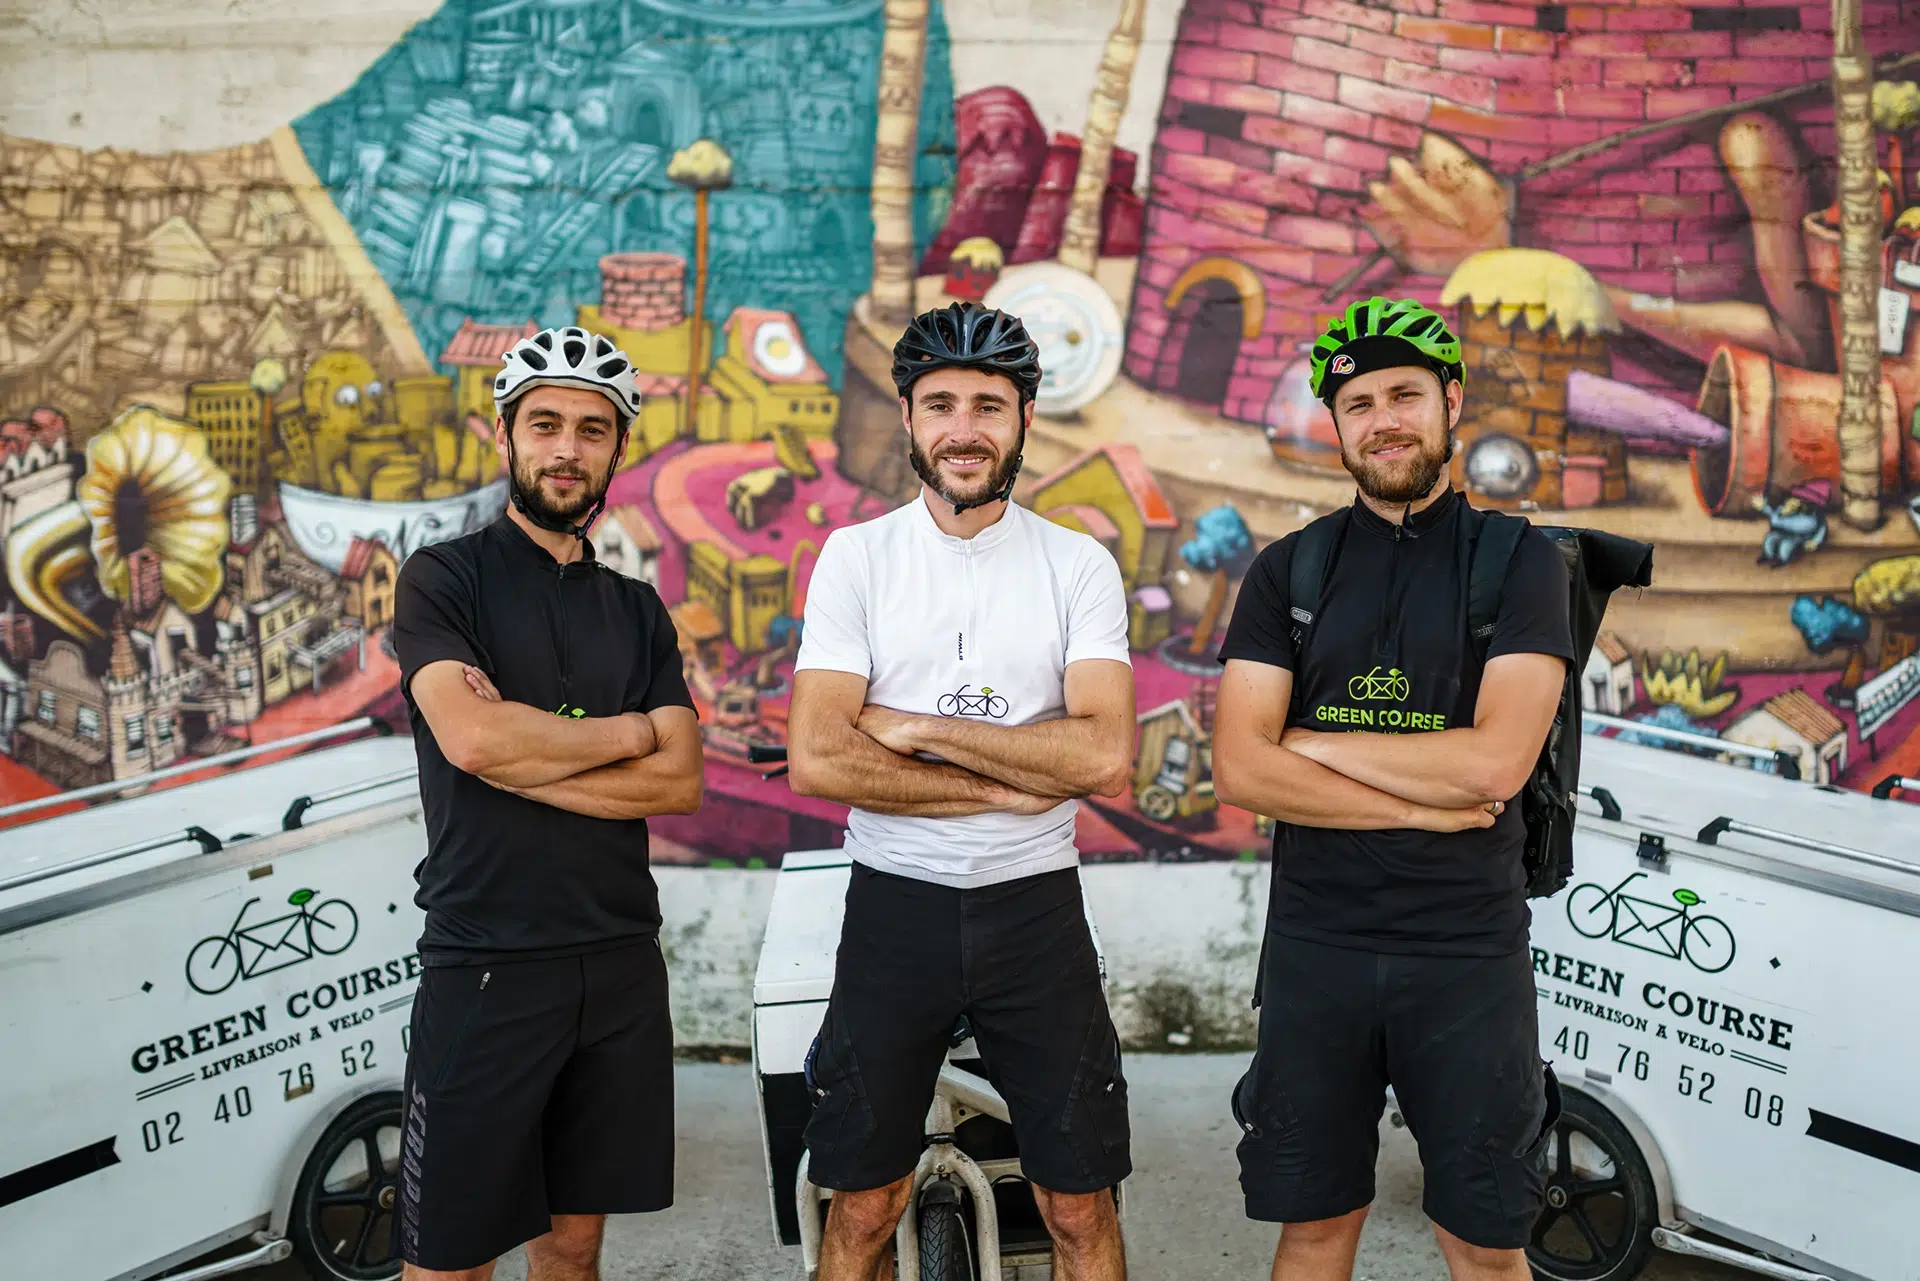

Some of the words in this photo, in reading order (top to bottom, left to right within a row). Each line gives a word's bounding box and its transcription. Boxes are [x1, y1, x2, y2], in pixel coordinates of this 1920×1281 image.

[1316, 705, 1374, 726] GREEN
[1378, 709, 1446, 731] COURSE
[131, 1005, 268, 1074] GREEN
[286, 952, 424, 1019] COURSE
[200, 1033, 302, 1080] LIVRAISON
[310, 1026, 322, 1041] A
[328, 1007, 374, 1033] VELO
[1530, 946, 1625, 998] REEN
[1642, 982, 1793, 1051] COURSE
[1554, 991, 1648, 1033] LIVRAISON
[1656, 1025, 1668, 1039] A
[1676, 1030, 1725, 1057] VELO
[141, 1111, 184, 1153] 02
[213, 1086, 252, 1124] 40
[278, 1062, 315, 1101] 76
[341, 1039, 377, 1077] 52
[1553, 1026, 1589, 1060] 40
[1617, 1043, 1649, 1081] 76
[1678, 1065, 1715, 1104] 52
[1744, 1087, 1784, 1127] 08
